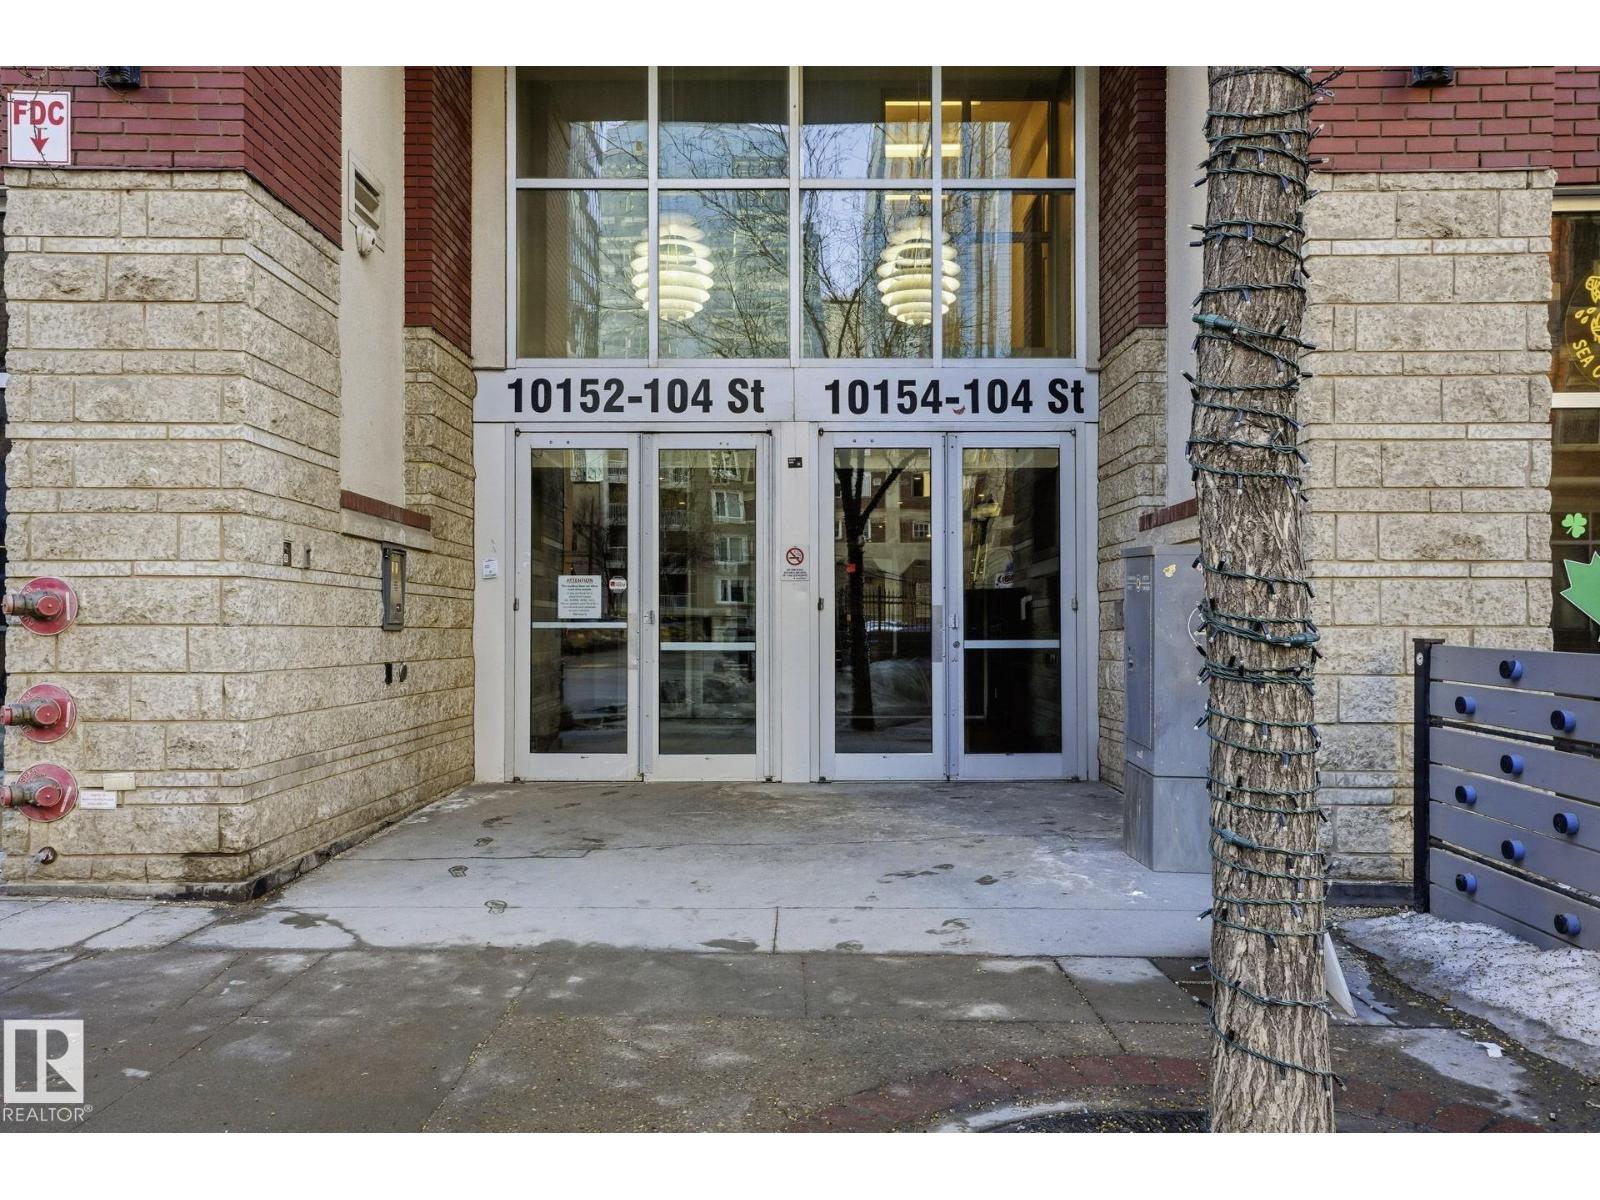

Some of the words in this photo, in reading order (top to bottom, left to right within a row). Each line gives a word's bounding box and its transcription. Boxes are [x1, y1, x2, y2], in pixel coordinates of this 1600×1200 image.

[13, 100, 65, 125] FDC
[1572, 339, 1595, 367] SEA
[507, 378, 713, 413] 10152-104
[727, 378, 765, 413] St
[824, 379, 1033, 414] 10154-104
[1047, 378, 1085, 414] St
